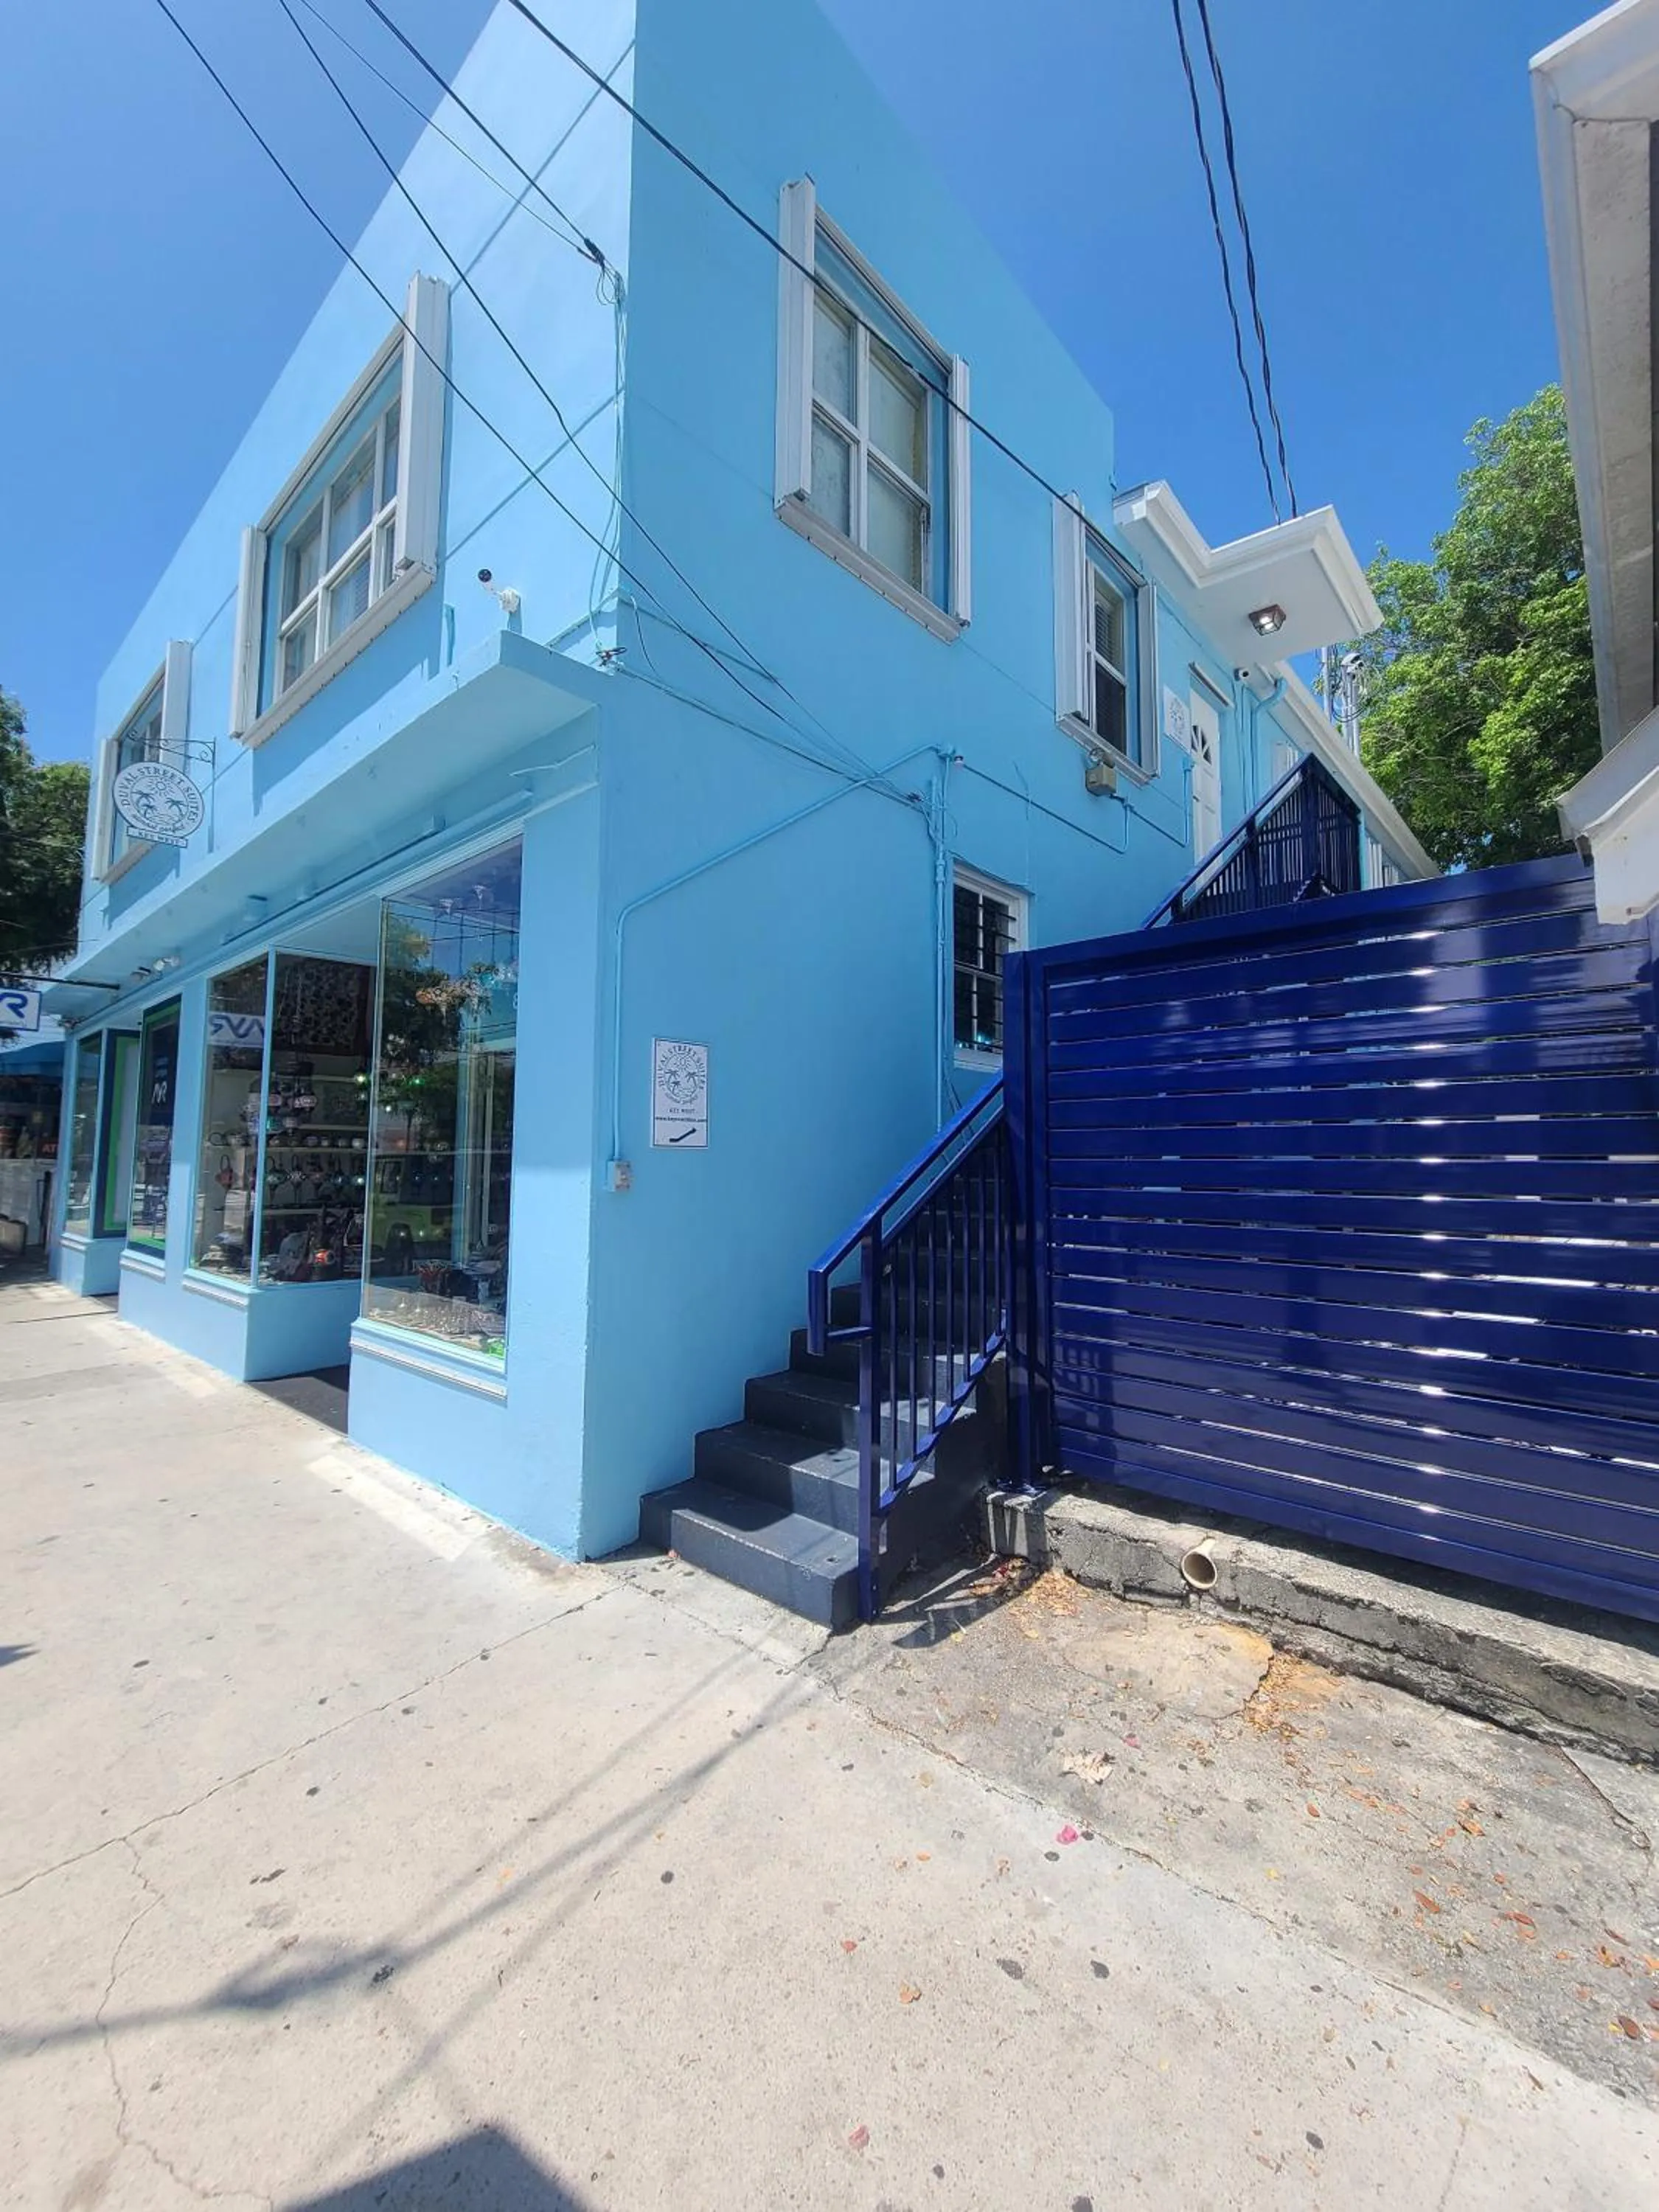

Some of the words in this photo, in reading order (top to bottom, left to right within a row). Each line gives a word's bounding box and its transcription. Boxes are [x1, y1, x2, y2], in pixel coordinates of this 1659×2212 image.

[119, 773, 138, 806] DUVAL
[138, 767, 184, 784] STREET
[184, 787, 198, 821] SUITES
[657, 1054, 667, 1087] DUVAL
[667, 1045, 697, 1057] STREET
